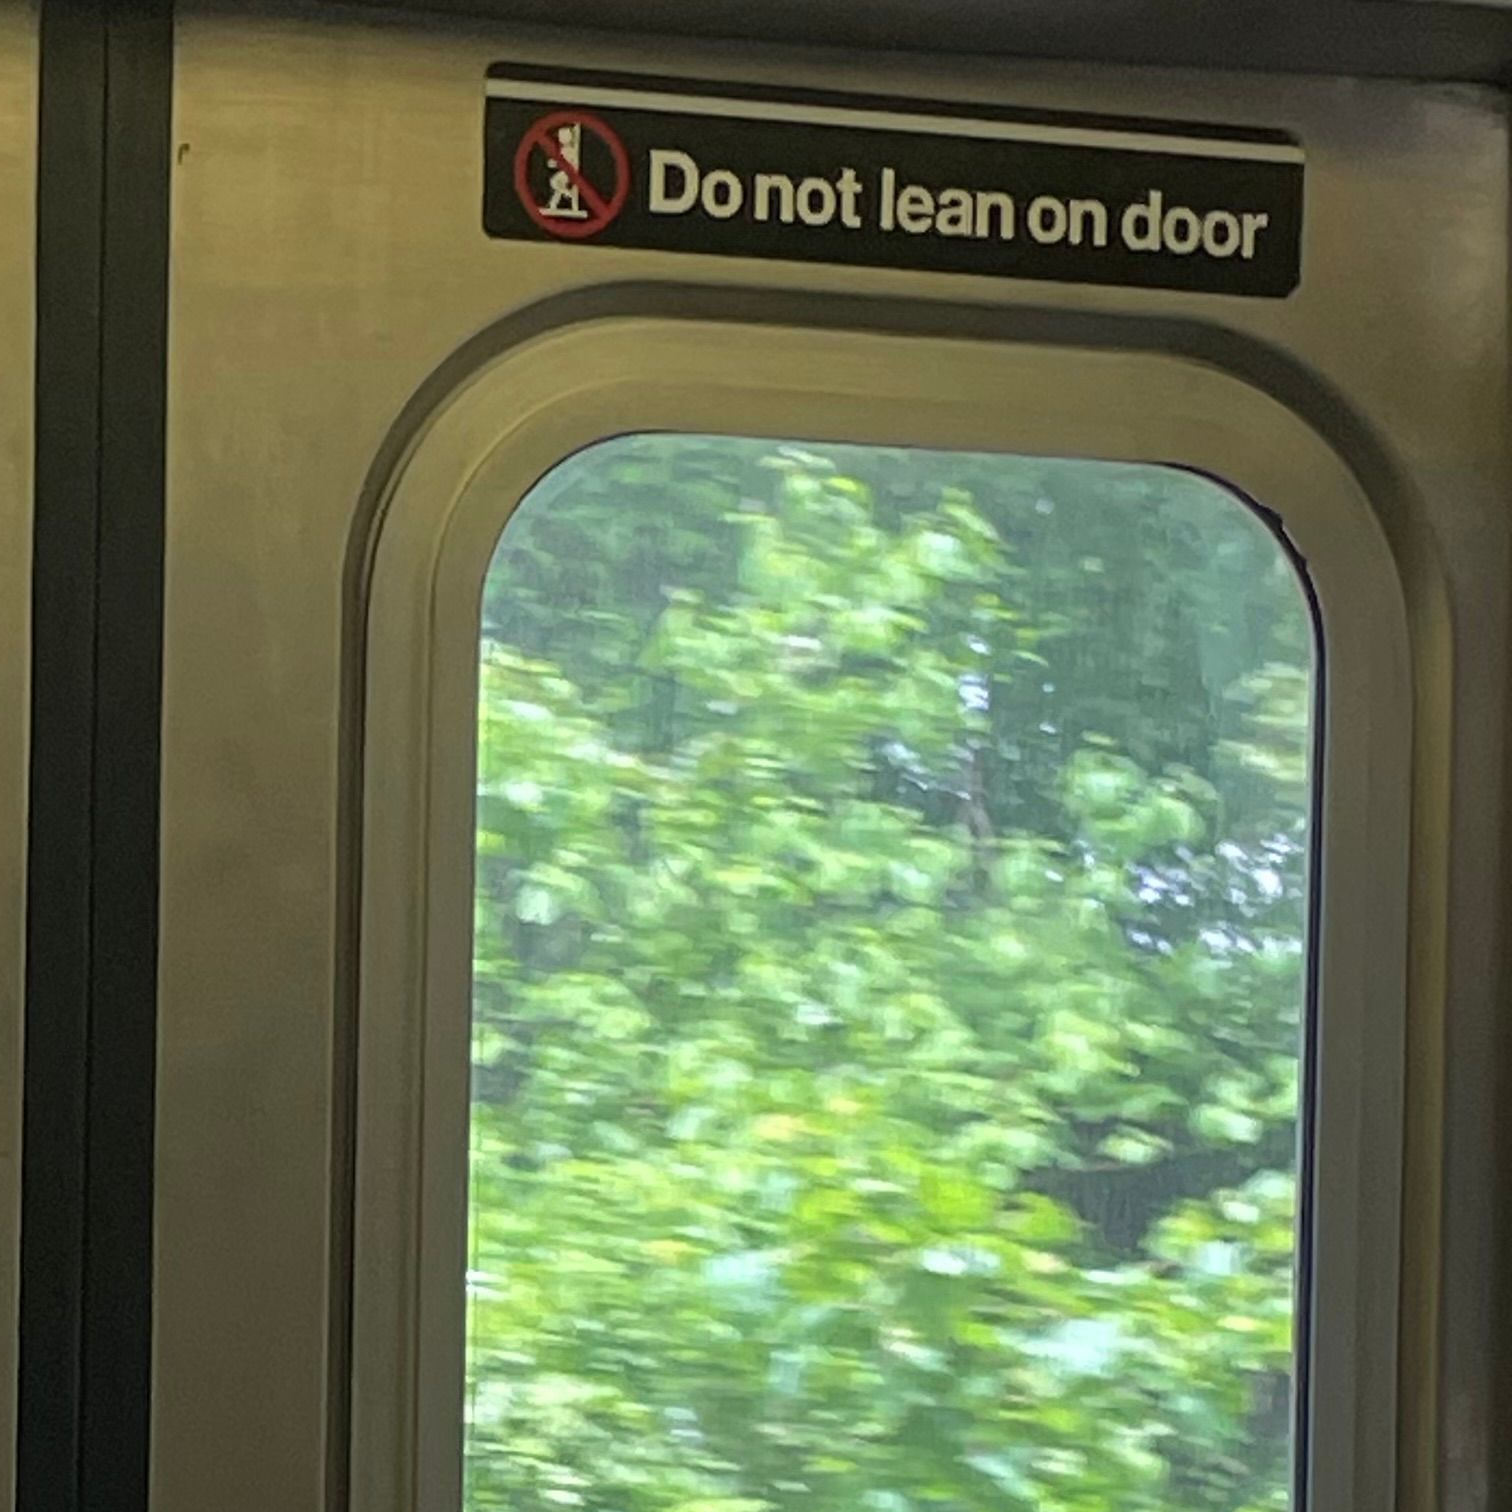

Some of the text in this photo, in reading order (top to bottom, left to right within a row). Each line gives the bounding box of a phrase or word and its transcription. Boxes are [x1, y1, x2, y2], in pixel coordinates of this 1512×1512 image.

[647, 148, 1270, 260] Do not lean on door
